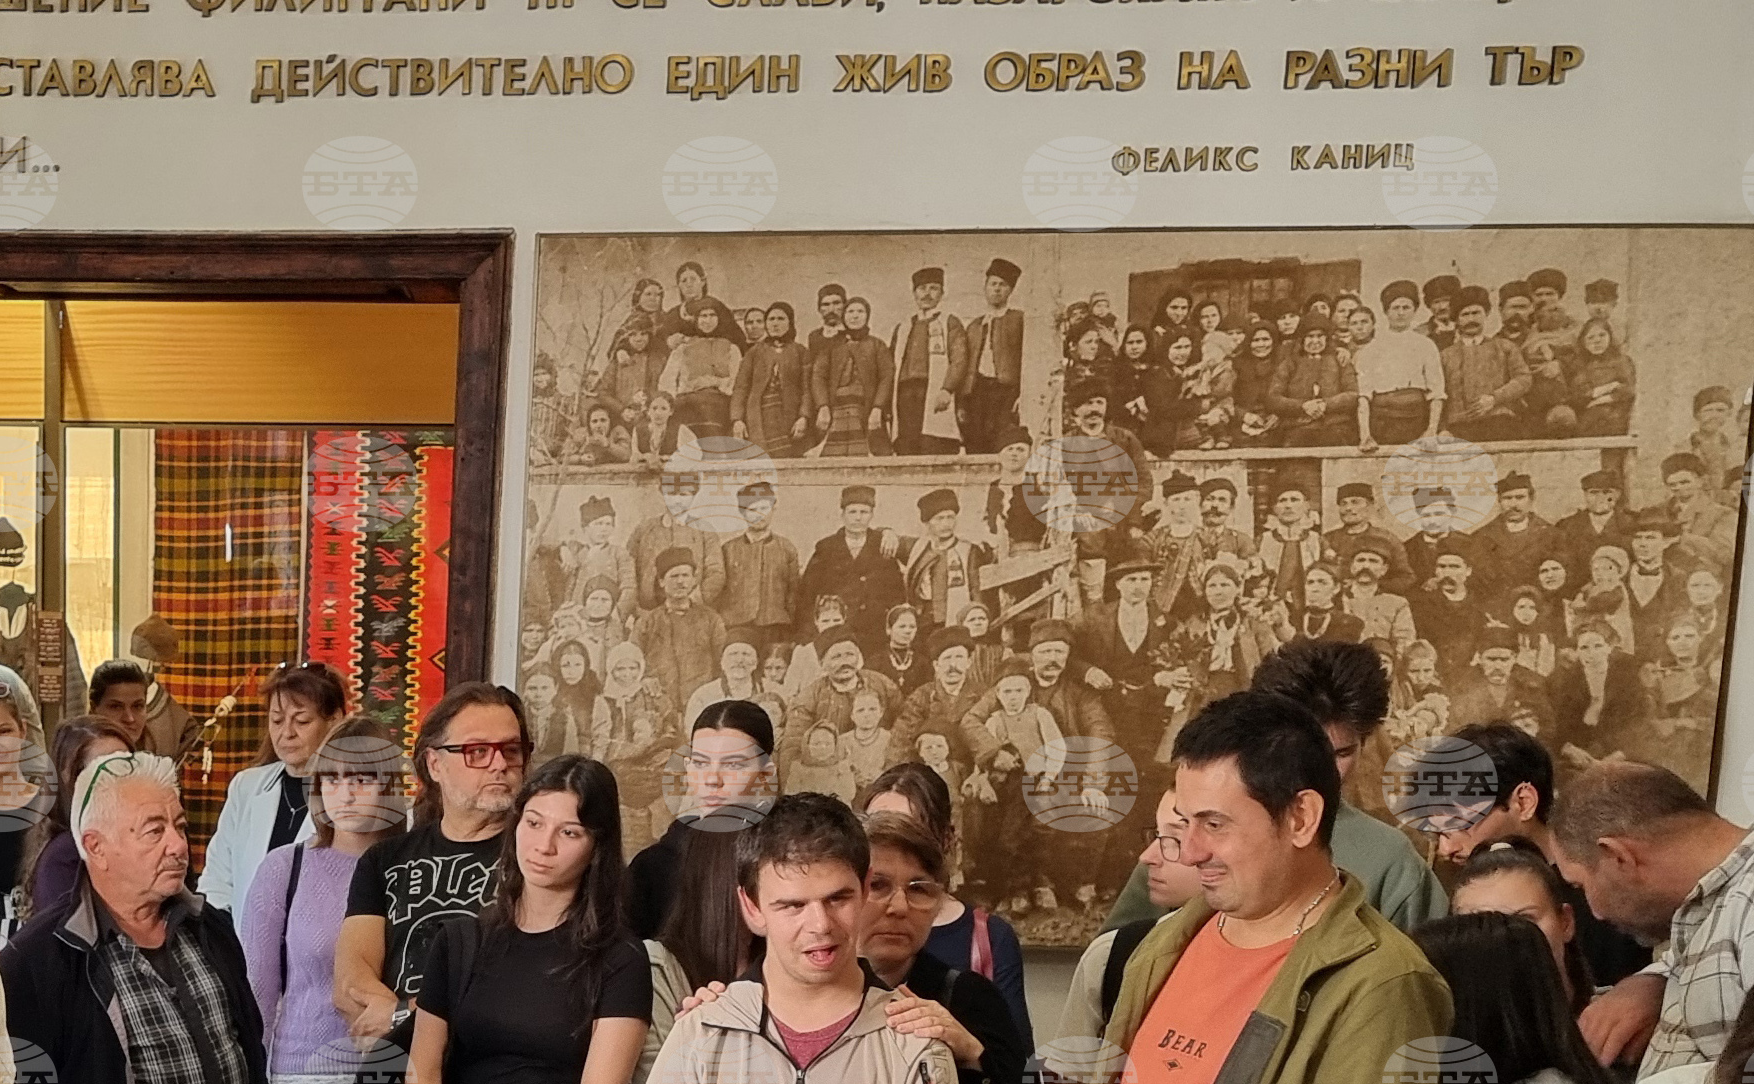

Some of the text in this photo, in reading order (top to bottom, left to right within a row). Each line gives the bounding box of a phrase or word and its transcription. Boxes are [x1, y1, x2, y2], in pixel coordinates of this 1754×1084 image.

[251, 53, 635, 103] ДЕЙСТВИТЕЛНО
[666, 54, 800, 101] ЕДИН
[833, 53, 951, 94] ЖИВ
[984, 50, 1146, 93] ОБРАЗ
[1177, 49, 1251, 91] НА
[1283, 47, 1455, 91] РАЗНИ
[1485, 45, 1585, 86] ТЪР
[1111, 142, 1414, 176] ФЕЛИКС КАНИЦ
[1158, 1029, 1207, 1058] BEAR
